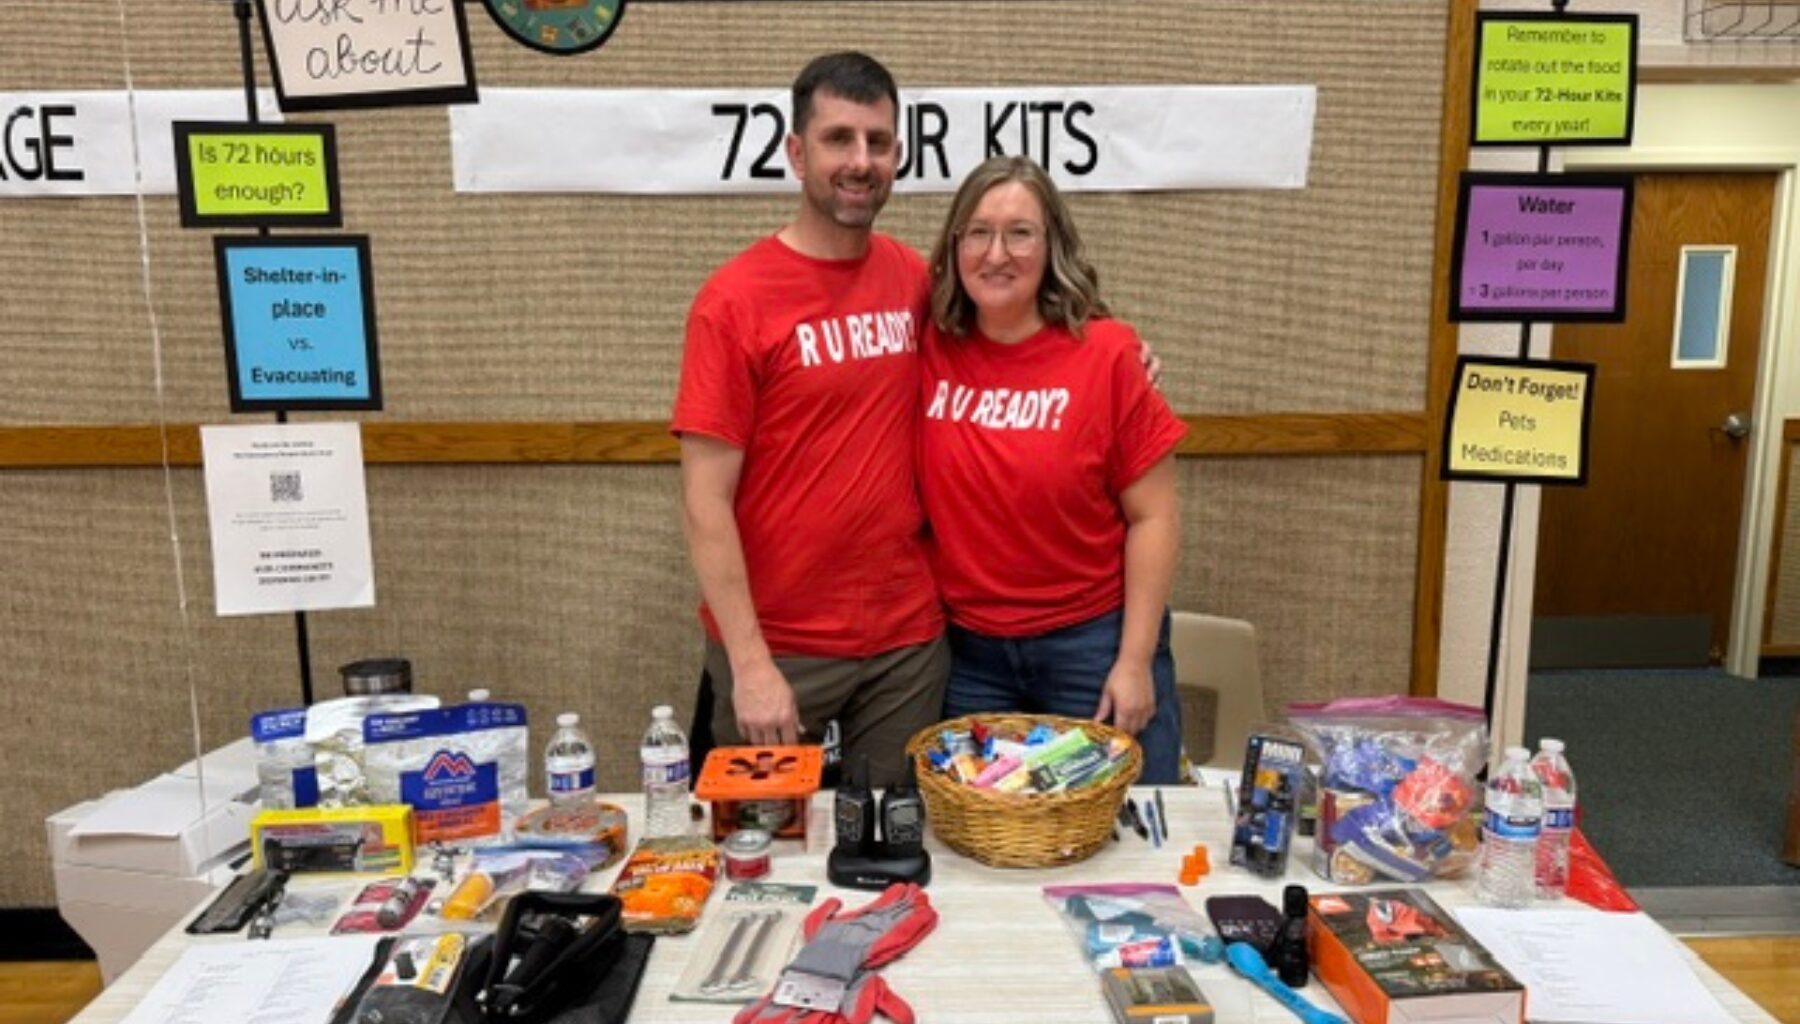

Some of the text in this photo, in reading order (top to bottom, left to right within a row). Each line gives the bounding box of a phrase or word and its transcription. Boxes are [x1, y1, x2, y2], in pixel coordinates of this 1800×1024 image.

[1507, 25, 1606, 44] Remember to
[306, 27, 442, 79] about
[1488, 59, 1621, 74] rotate out the food
[1485, 85, 1622, 104] in your 72-Hour Kits
[1512, 118, 1591, 134] every year!
[0, 105, 84, 180] GE
[711, 103, 787, 180] 72
[984, 100, 1098, 176] KITS
[199, 143, 316, 166] Is 72 hours
[215, 182, 305, 205] enough?
[1518, 195, 1575, 214] Water
[1482, 230, 1489, 244] 1
[1493, 232, 1530, 248] gallon
[1532, 234, 1553, 248] per
[244, 266, 347, 284] Shelter-in-
[1516, 259, 1564, 272] per day
[1480, 284, 1489, 298] 3
[1492, 286, 1537, 300] gallons
[1541, 287, 1561, 300] per
[1565, 288, 1608, 300] person
[272, 299, 326, 320] place
[288, 338, 315, 350] vs.
[796, 322, 822, 367] R
[821, 317, 845, 364] U
[251, 367, 357, 387] Evacuating
[1467, 373, 1579, 403] Don't Forget!
[926, 379, 1070, 431] R U READY?
[1499, 410, 1536, 432] Pets
[1462, 443, 1568, 469] Medications
